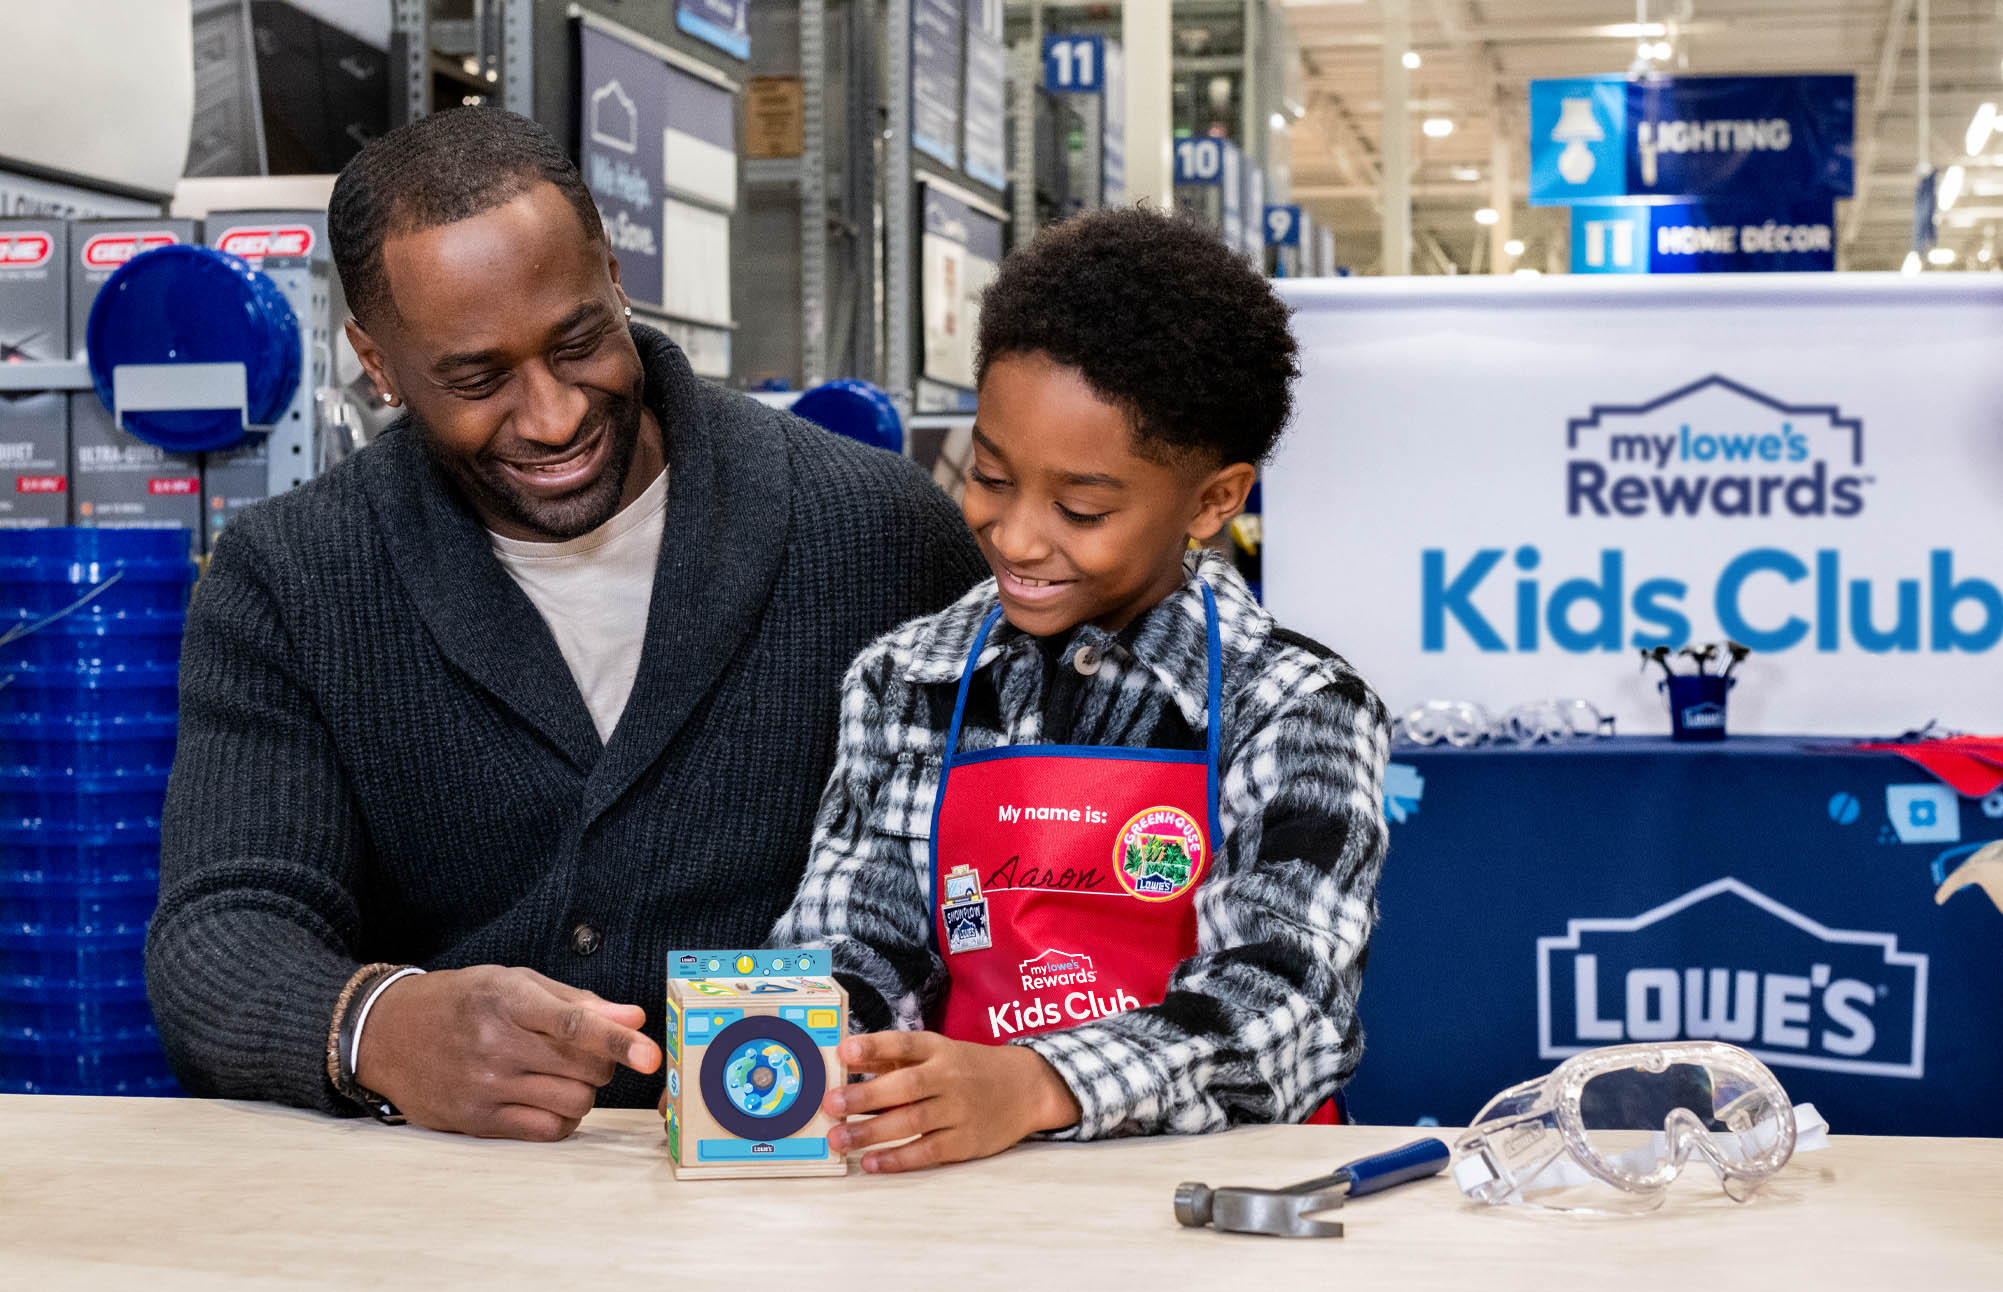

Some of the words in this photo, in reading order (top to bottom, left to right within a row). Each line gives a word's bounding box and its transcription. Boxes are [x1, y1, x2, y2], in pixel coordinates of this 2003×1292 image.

[1052, 41, 1095, 86] 11
[1638, 119, 1792, 152] LIGHTING
[1178, 140, 1220, 179] 10
[1268, 205, 1292, 241] 9
[1657, 225, 1738, 255] HOME
[1740, 219, 1832, 254] DÉCOR
[1610, 422, 1809, 469] mylowe's
[1567, 460, 1865, 517] Rewards
[1421, 545, 1691, 653] Kids
[1714, 547, 2003, 653] Club
[998, 805, 1021, 824] My
[1024, 806, 1081, 822] name
[1085, 806, 1107, 824] is:
[1124, 811, 1200, 852] GREENHOUSE
[983, 855, 1105, 889] Aaron
[1021, 968, 1096, 991] Rewards
[988, 998, 1062, 1038] Kids
[1064, 988, 1141, 1020] Club
[1575, 953, 1877, 1056] LOWE'S
